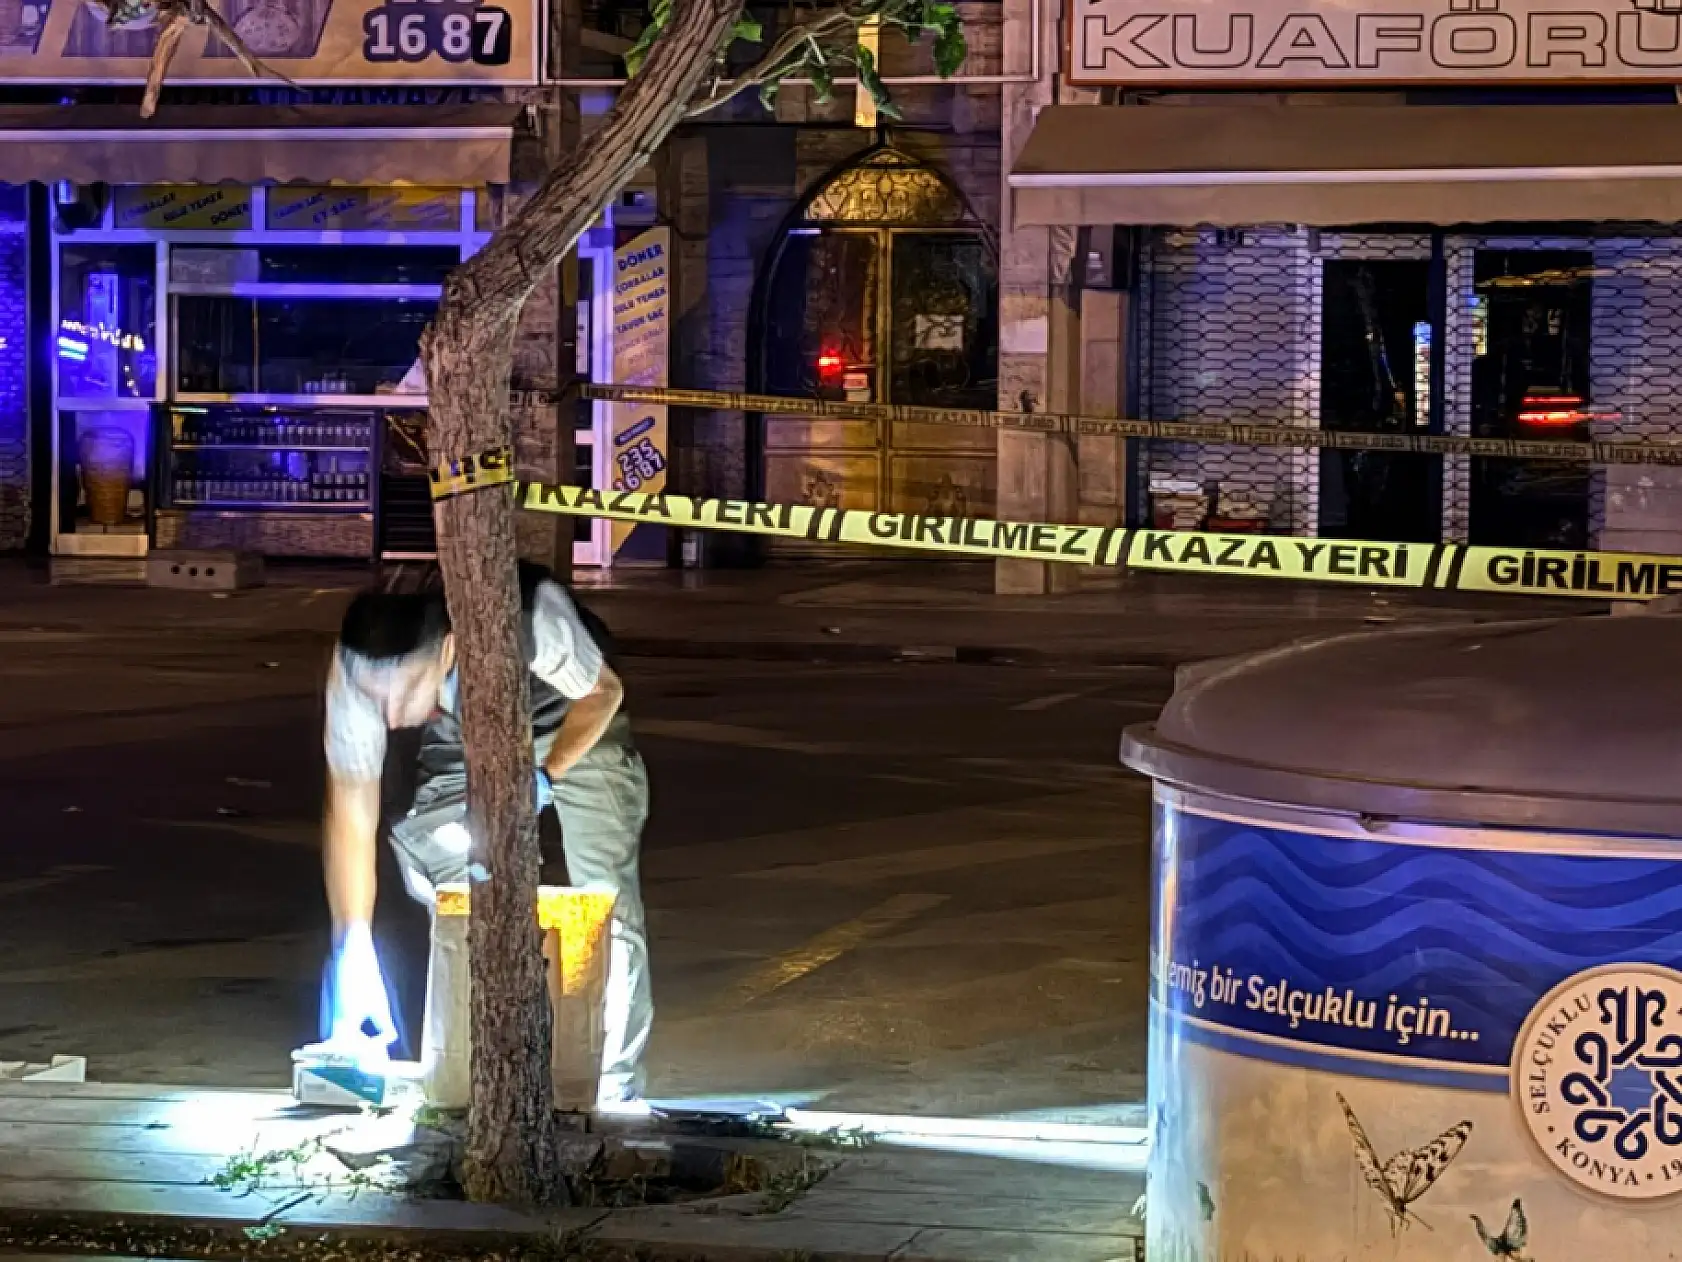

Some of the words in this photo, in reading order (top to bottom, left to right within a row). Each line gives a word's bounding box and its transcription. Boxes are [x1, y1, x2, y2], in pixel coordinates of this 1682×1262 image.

[370, 13, 427, 55] 16
[442, 12, 504, 55] 87
[538, 482, 671, 517] KAZA
[1142, 532, 1282, 571] KAZA
[1293, 542, 1409, 579] YERİ
[1167, 958, 1208, 1009] emiz
[1210, 963, 1243, 1005] bir
[1245, 974, 1378, 1030] Selçuklu
[1384, 993, 1480, 1045] için...
[1529, 992, 1592, 1114] SELÇUKLU
[1555, 1136, 1640, 1186] KONYA
